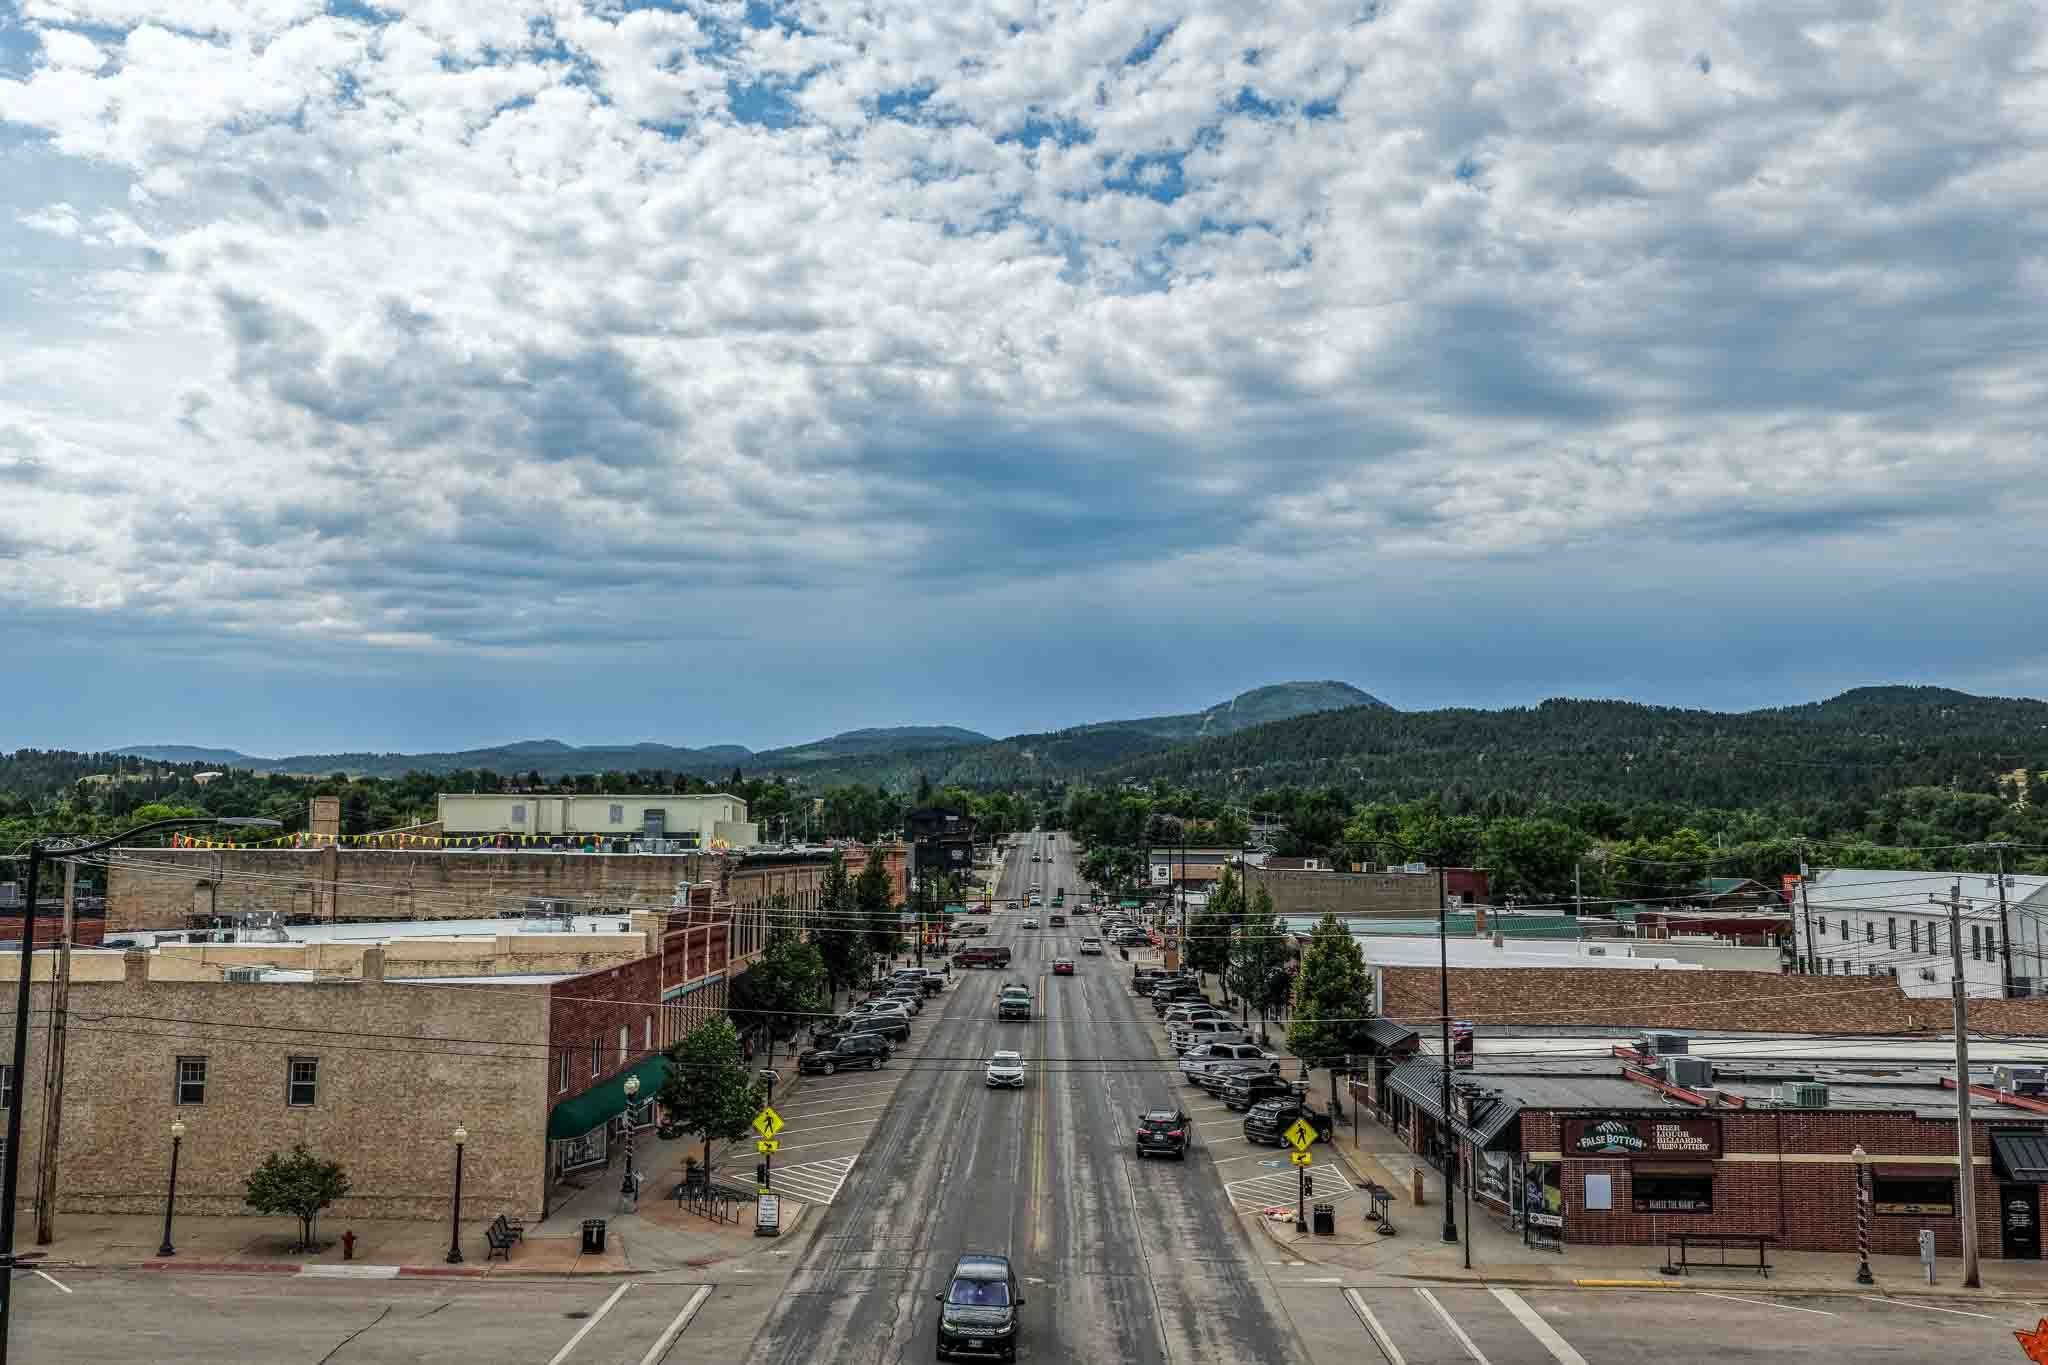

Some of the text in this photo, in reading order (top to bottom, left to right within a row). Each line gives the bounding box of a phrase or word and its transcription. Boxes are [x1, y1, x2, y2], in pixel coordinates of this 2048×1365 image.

[1656, 1130, 1689, 1138] LIQUOR
[1580, 1134, 1643, 1148] FALSE BOTTOM
